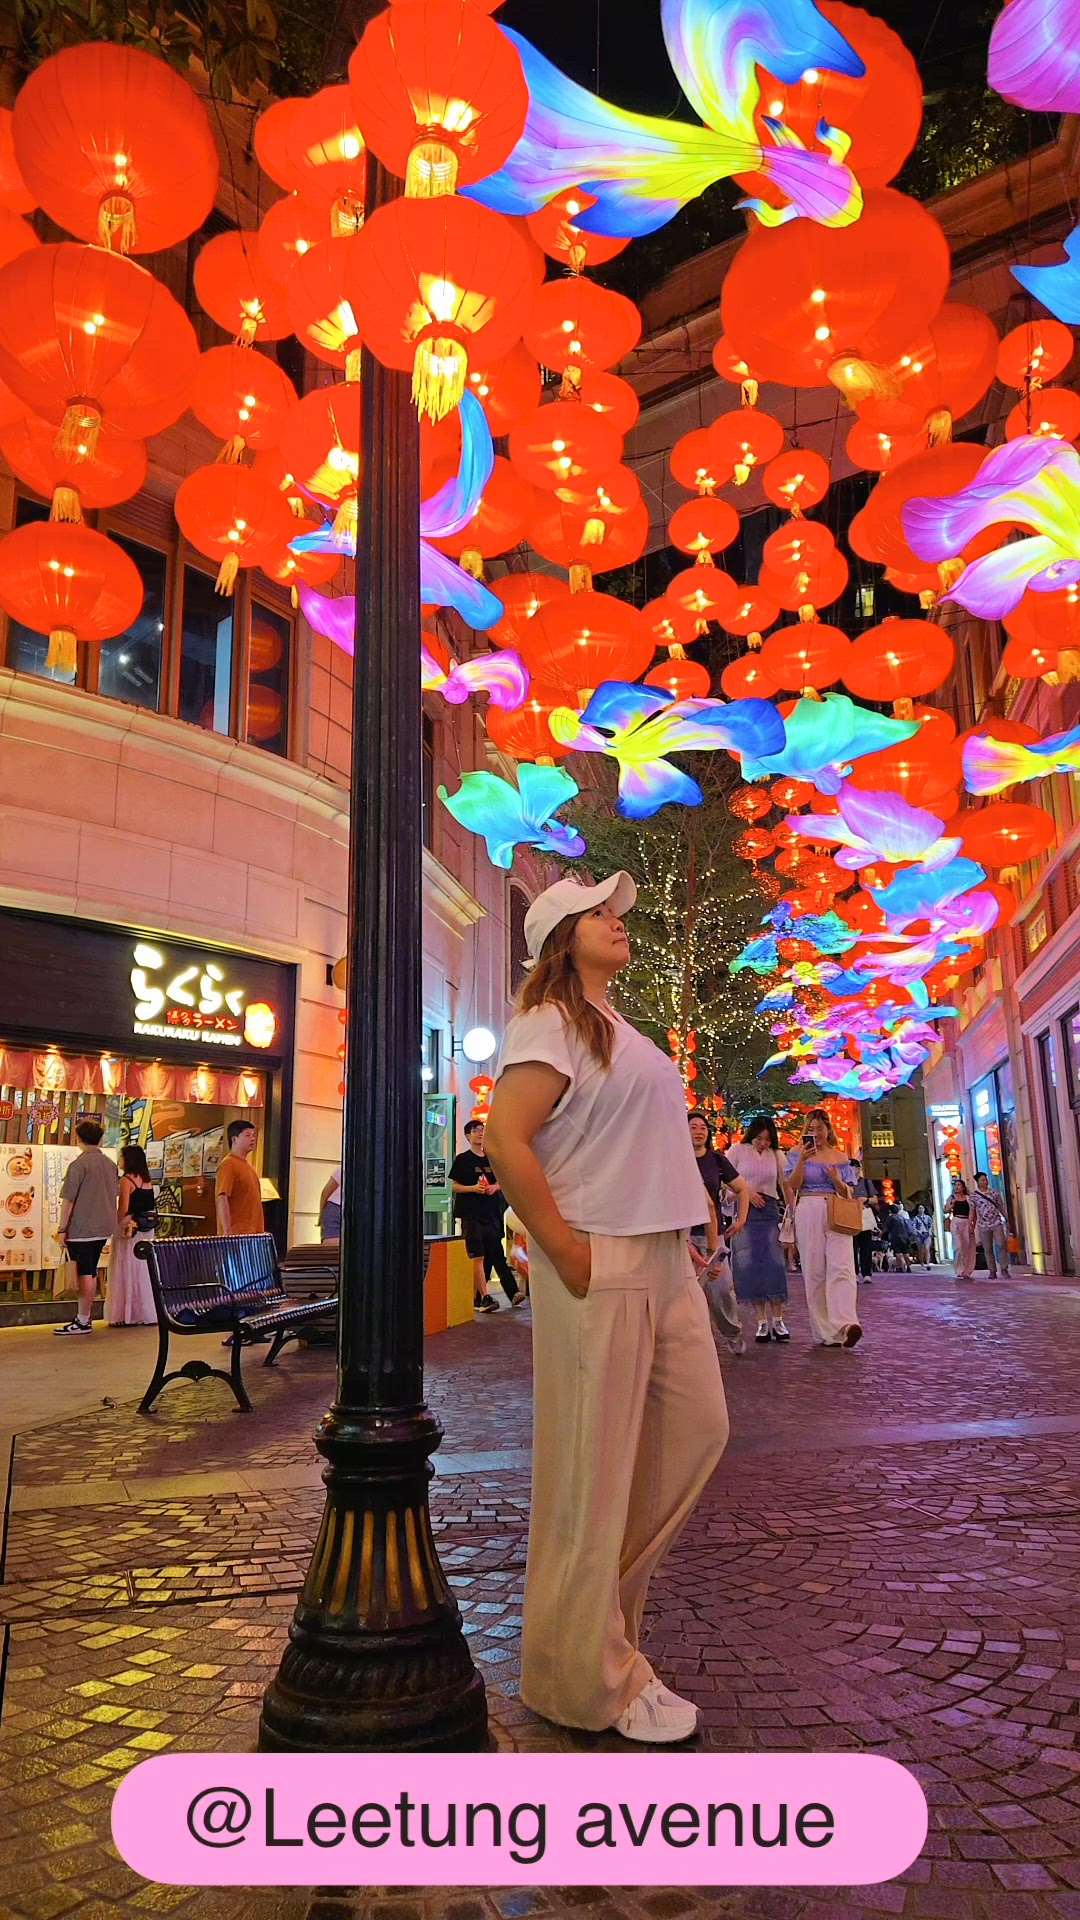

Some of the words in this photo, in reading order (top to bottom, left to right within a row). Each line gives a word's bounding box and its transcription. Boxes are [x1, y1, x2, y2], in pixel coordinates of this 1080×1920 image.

[130, 944, 244, 1020] らくらく
[167, 1009, 239, 1031] 博多ラーメン
[133, 1022, 201, 1041] RAKURAKU
[201, 1031, 242, 1047] RAMEN
